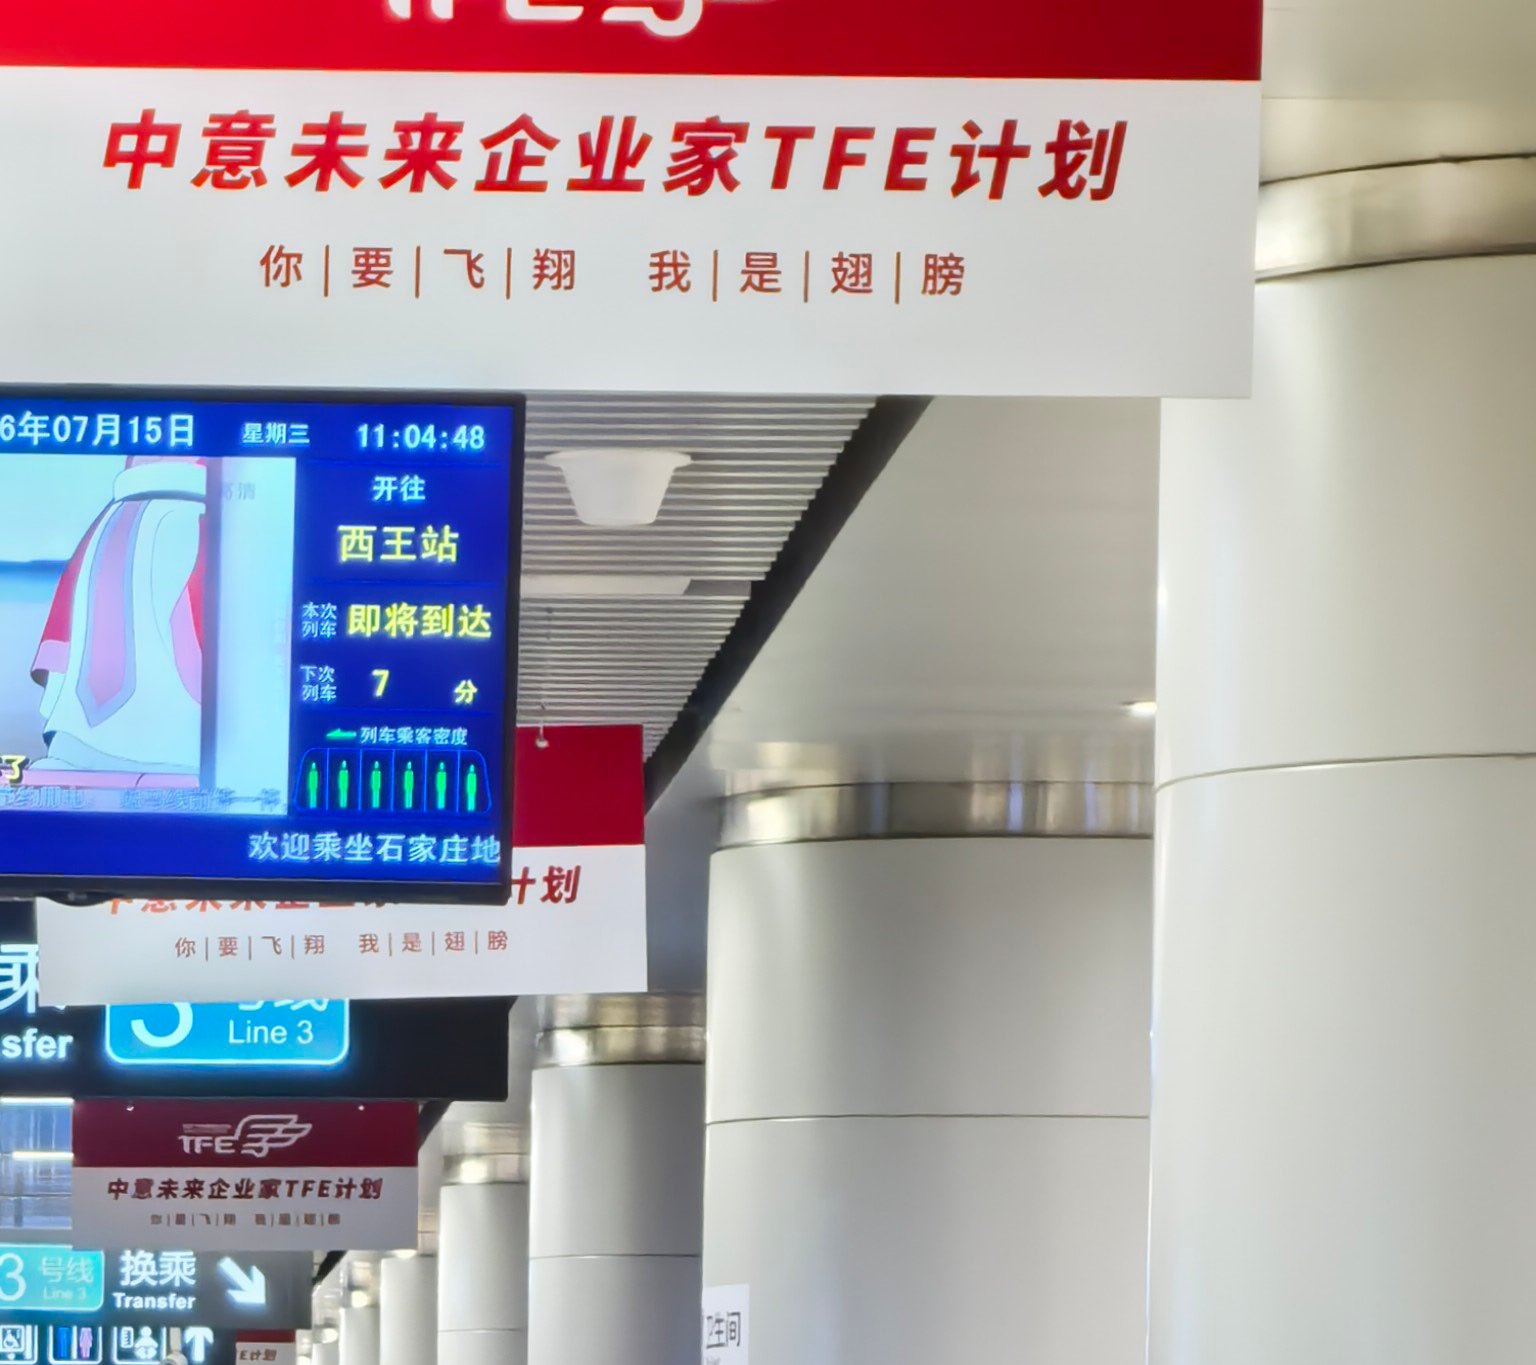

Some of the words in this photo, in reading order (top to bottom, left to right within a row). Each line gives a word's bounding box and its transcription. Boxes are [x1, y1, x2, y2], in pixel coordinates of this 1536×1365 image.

[101, 107, 1129, 203] 中意未来企业家TFE计划
[243, 422, 310, 445] 星期三
[358, 423, 485, 449] 11:04:48
[372, 475, 426, 501] 开往
[337, 524, 459, 563] 西王站
[302, 601, 337, 619] 本次
[347, 602, 492, 638] 即将到达
[302, 620, 337, 638] 列车
[300, 665, 335, 683] 下次
[371, 669, 390, 697] 7
[453, 679, 478, 704] 分
[302, 684, 337, 702] 列车
[360, 727, 468, 746] 列车乘客密度
[248, 831, 502, 865] 欢迎乘坐石家庄地
[229, 1020, 288, 1044] Line
[297, 1020, 313, 1044] 3
[120, 1250, 197, 1287] 换乘
[113, 1292, 197, 1310] Transfer
